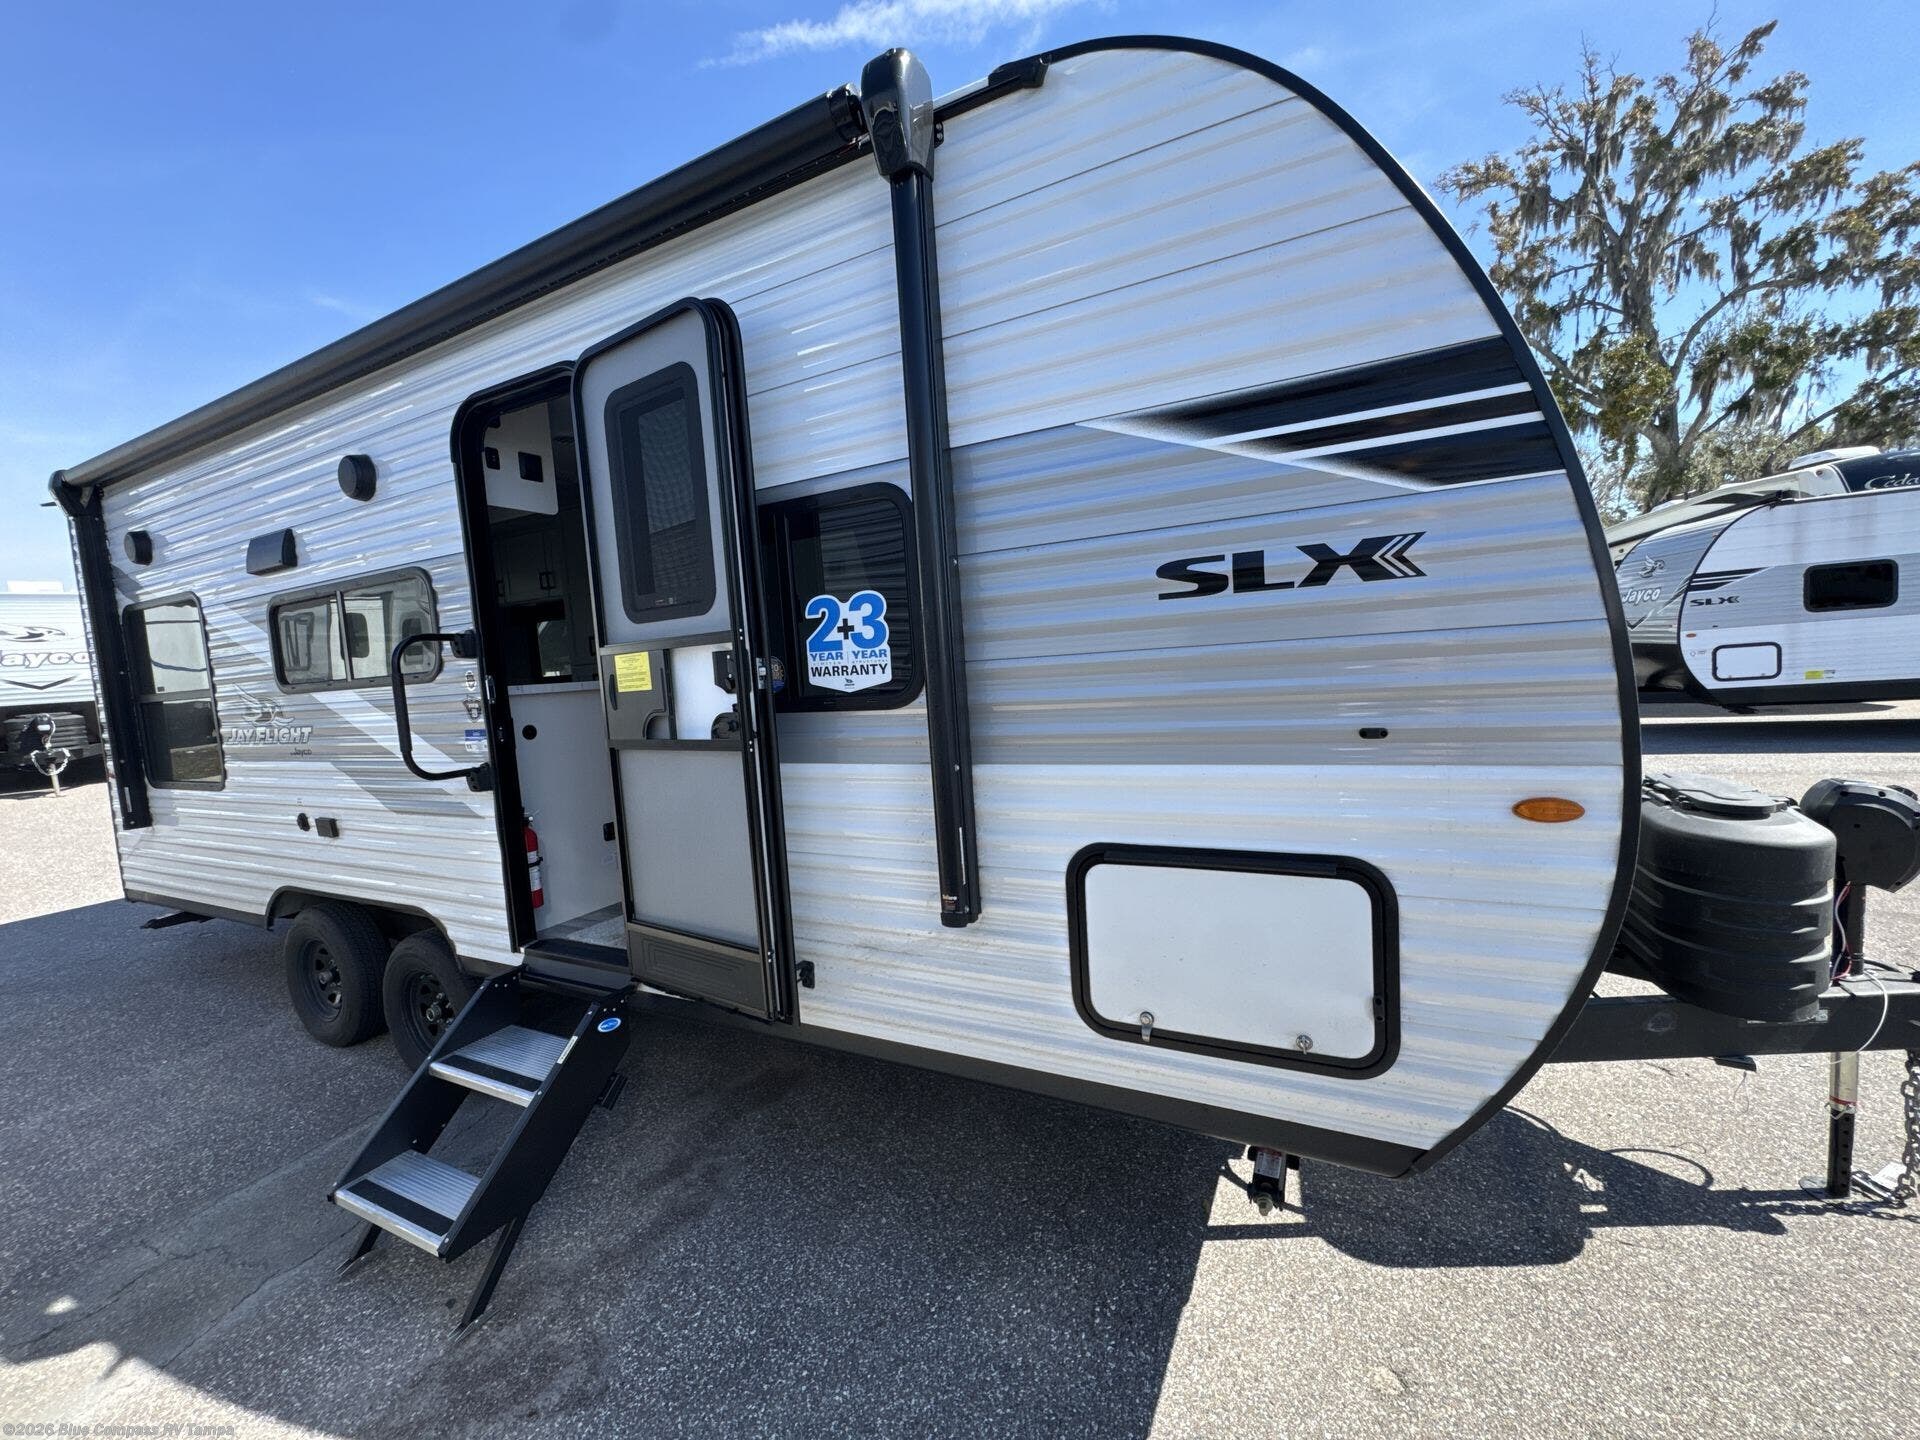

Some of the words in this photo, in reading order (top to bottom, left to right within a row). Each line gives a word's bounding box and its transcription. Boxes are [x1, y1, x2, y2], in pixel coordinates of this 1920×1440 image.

[1155, 531, 1427, 600] SLX
[1621, 587, 1661, 606] Jayco
[1690, 595, 1740, 607] SLX
[0, 650, 90, 669] ayco
[809, 651, 844, 662] YEAR
[851, 648, 888, 660] YEAR
[811, 663, 888, 677] WARRANTY
[226, 727, 254, 745] JAY
[254, 726, 313, 745] FLIGHT
